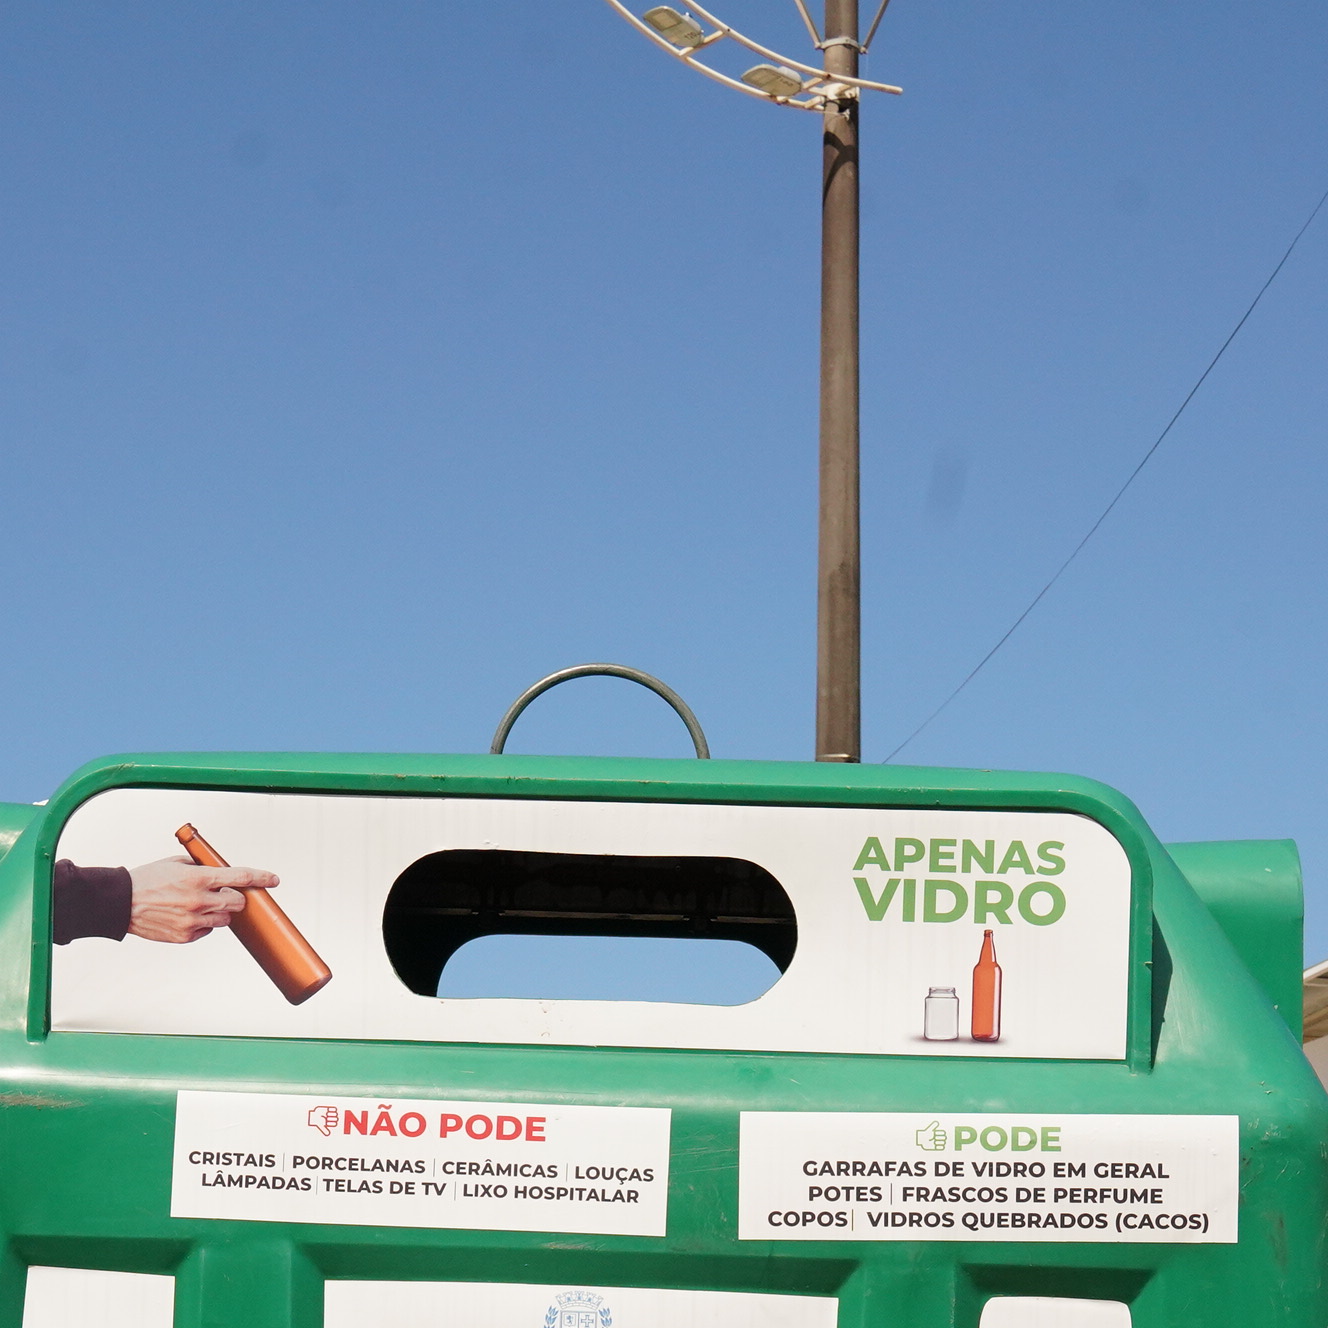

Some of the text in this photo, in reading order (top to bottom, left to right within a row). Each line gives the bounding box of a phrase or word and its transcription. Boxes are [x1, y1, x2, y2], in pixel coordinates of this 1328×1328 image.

[854, 838, 1066, 876] APENAS
[854, 877, 1067, 927] VIDRO
[345, 1105, 547, 1142] NÃO PODE
[956, 1127, 1062, 1153] PODE
[190, 1152, 655, 1186] CRISTAIS PORCELANAS CERÂMICAS LOUÇAS
[804, 1162, 1170, 1179] GARRAFAS DE VIDRO EM GERAL
[203, 1171, 639, 1203] LÂMPADAS TELAS DE TV LIXO HOSPITALAR
[810, 1187, 1164, 1205] POTES FRASCOS DE PERFUME
[769, 1212, 1209, 1234] COPOS VIDROS QUEBRADOS (CACOS)
